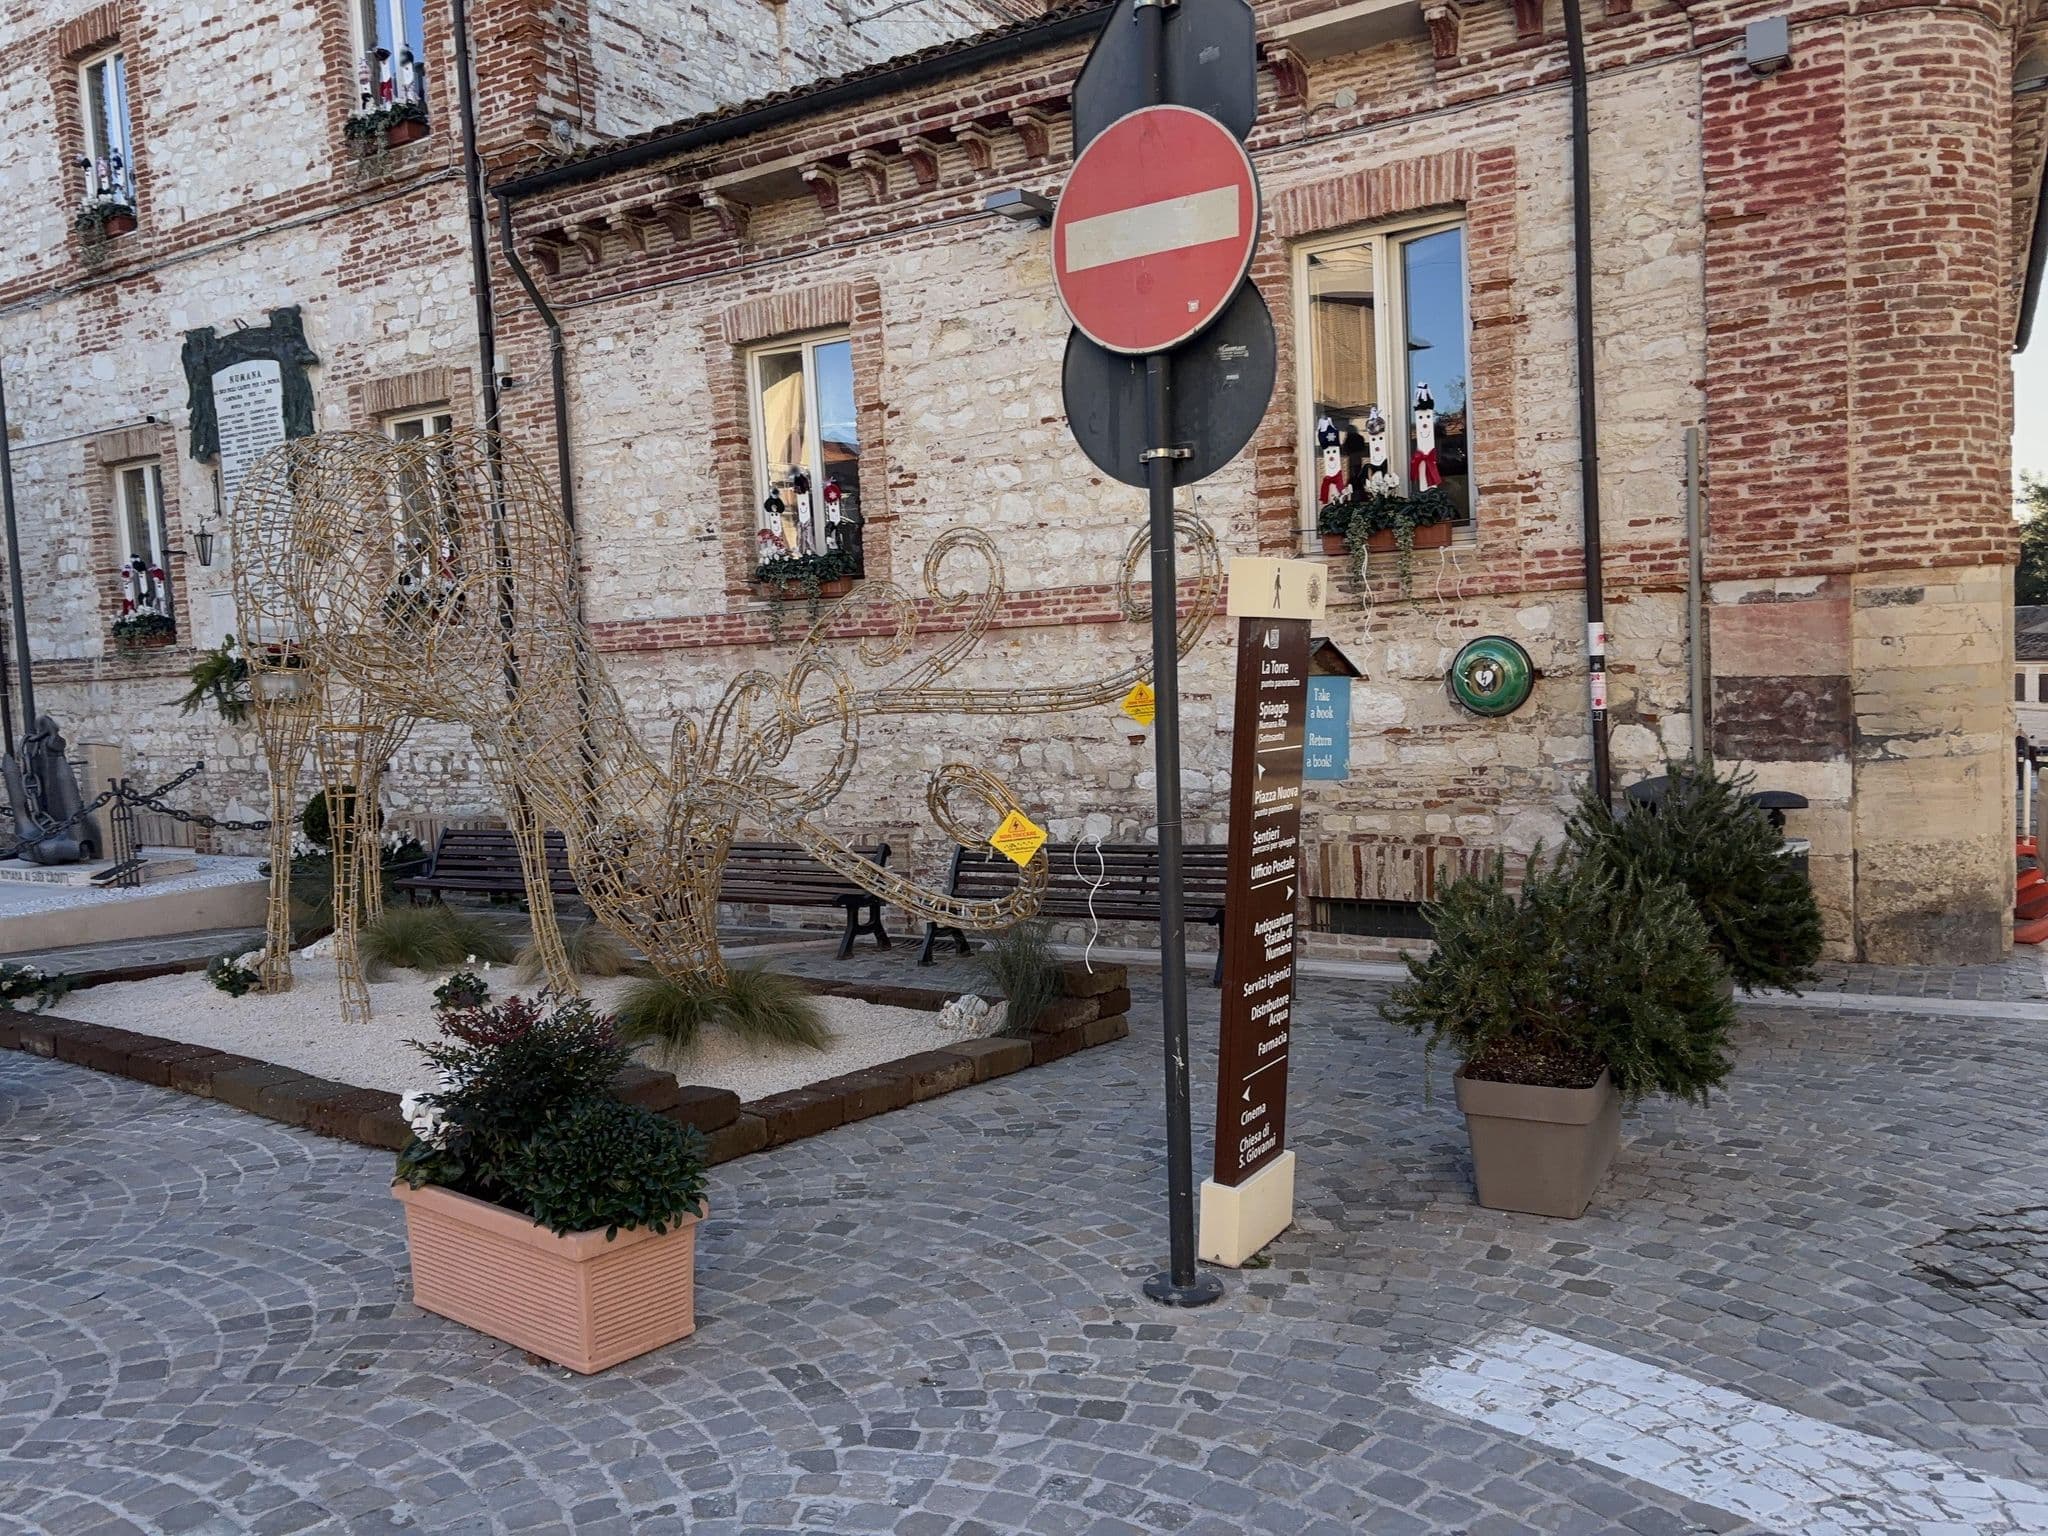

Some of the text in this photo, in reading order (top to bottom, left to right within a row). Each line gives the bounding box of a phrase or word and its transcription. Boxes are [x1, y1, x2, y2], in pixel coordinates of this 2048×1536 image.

[1261, 660, 1289, 675] La Torre
[1313, 687, 1331, 701] Take
[1259, 700, 1289, 719] Spiaggia
[1310, 705, 1334, 719] a book
[1308, 733, 1333, 746] Return
[1306, 754, 1333, 768] a book!
[1255, 786, 1298, 804] Piazza Nuova
[1253, 825, 1280, 845] Sentieri
[1251, 855, 1295, 880] Ufficio Postale
[1254, 912, 1293, 936] Antiquarium
[1264, 924, 1293, 947] Statale di
[1265, 943, 1292, 961] Numana
[1243, 963, 1292, 997] Servizi Igienici
[1251, 994, 1290, 1021] Distributore
[1268, 1008, 1289, 1027] Acqua
[1258, 1030, 1287, 1056] Farmacia
[1240, 1103, 1267, 1126] Cinema
[1239, 1121, 1270, 1153] Chiesa di
[1238, 1132, 1277, 1168] S. Giovanni
